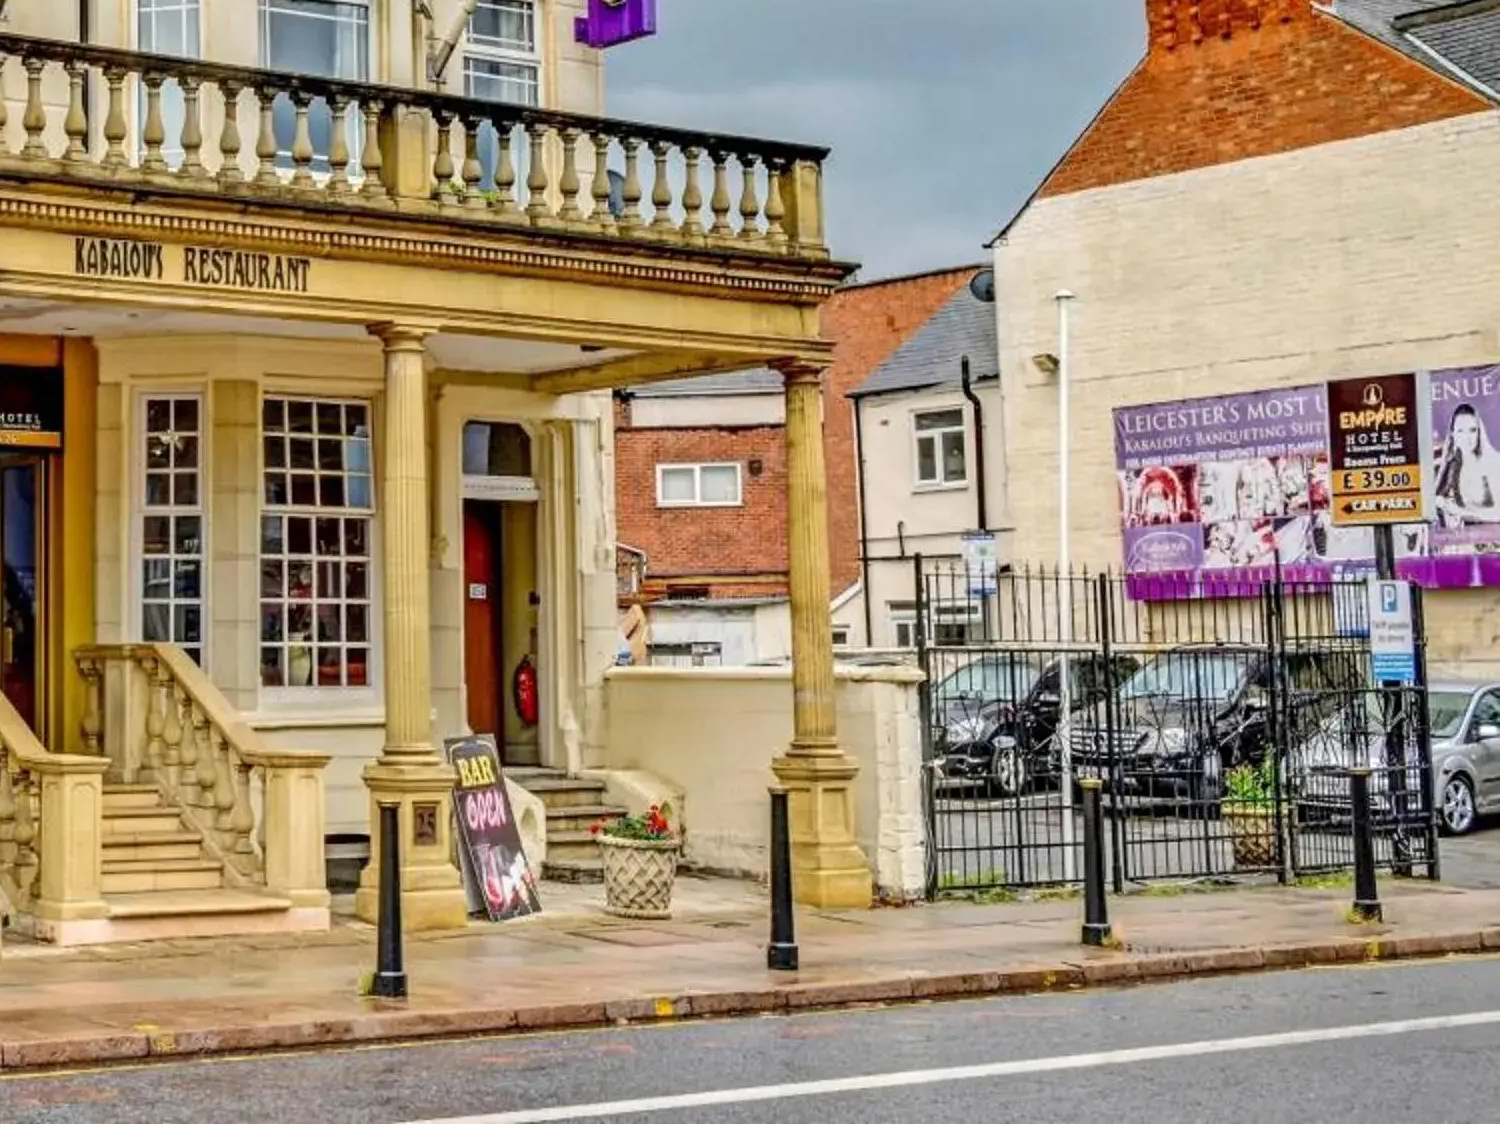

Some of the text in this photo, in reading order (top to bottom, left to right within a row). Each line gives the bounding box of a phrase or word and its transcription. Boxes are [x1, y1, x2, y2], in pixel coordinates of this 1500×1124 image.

[75, 237, 310, 292] KABALOU'S RESTAURANT
[1125, 401, 1240, 433] LEICESTER'S
[1247, 396, 1309, 421] MOST
[1340, 403, 1407, 430] EMPIRE
[1196, 425, 1286, 446] BANQUETING
[1345, 430, 1403, 445] HOTEL
[1361, 470, 1411, 489] 39.00
[1352, 497, 1415, 511] CAR PARK
[457, 756, 495, 787] BAR
[466, 790, 507, 830] OPEN
[417, 810, 437, 839] 25
